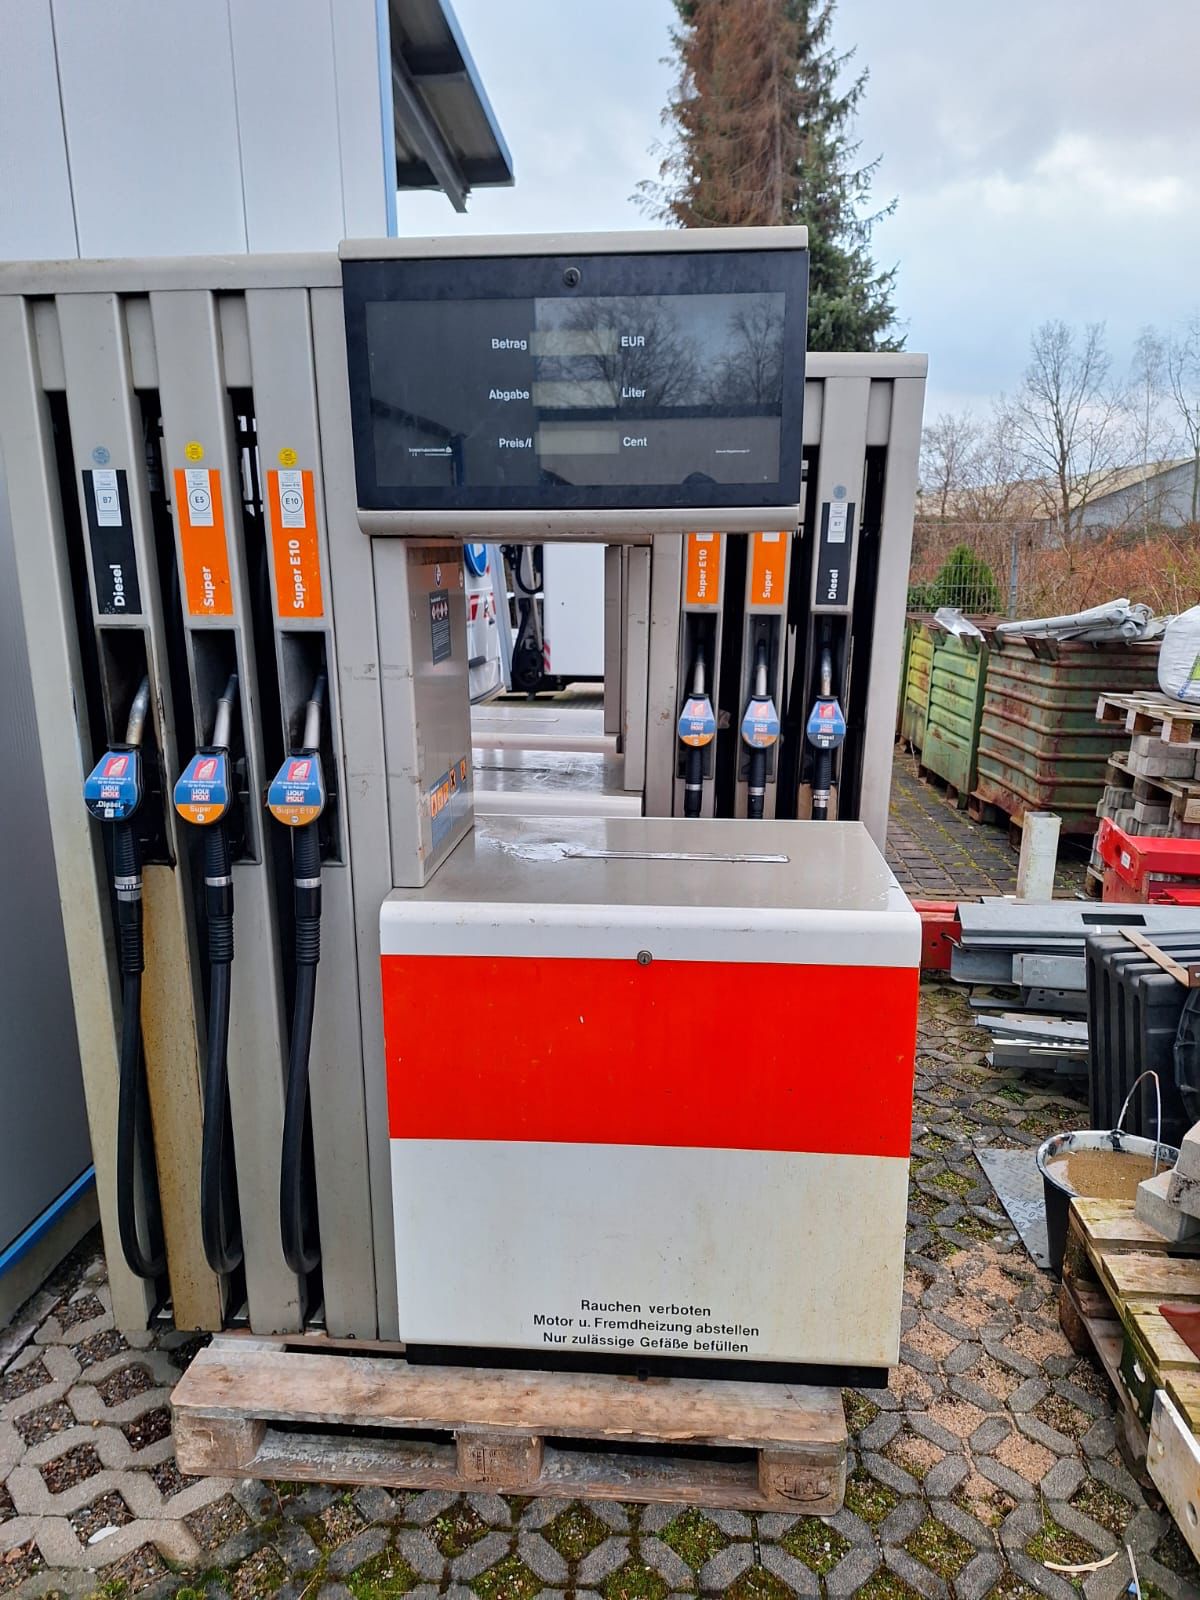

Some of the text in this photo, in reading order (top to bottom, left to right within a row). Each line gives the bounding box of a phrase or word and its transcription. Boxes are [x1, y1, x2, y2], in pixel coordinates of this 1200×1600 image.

[491, 336, 645, 350] Betrag EUR
[489, 387, 646, 401] Abgabe Liter
[623, 437, 648, 447] Cent
[195, 496, 205, 504] E5
[288, 539, 301, 565] E10
[697, 549, 707, 598] Super E10
[762, 569, 773, 598] Super
[109, 564, 126, 607] Diesel
[202, 566, 216, 608] Super
[293, 568, 307, 609] Super
[828, 569, 839, 600] Diesel
[190, 805, 212, 813] Super
[276, 807, 299, 815] Super
[581, 1300, 711, 1316] Rauchen verboten
[533, 1314, 759, 1336] Motor u. Fremdheizung abstellen
[543, 1332, 748, 1352] Nur zulässige Gefäße befüllen
